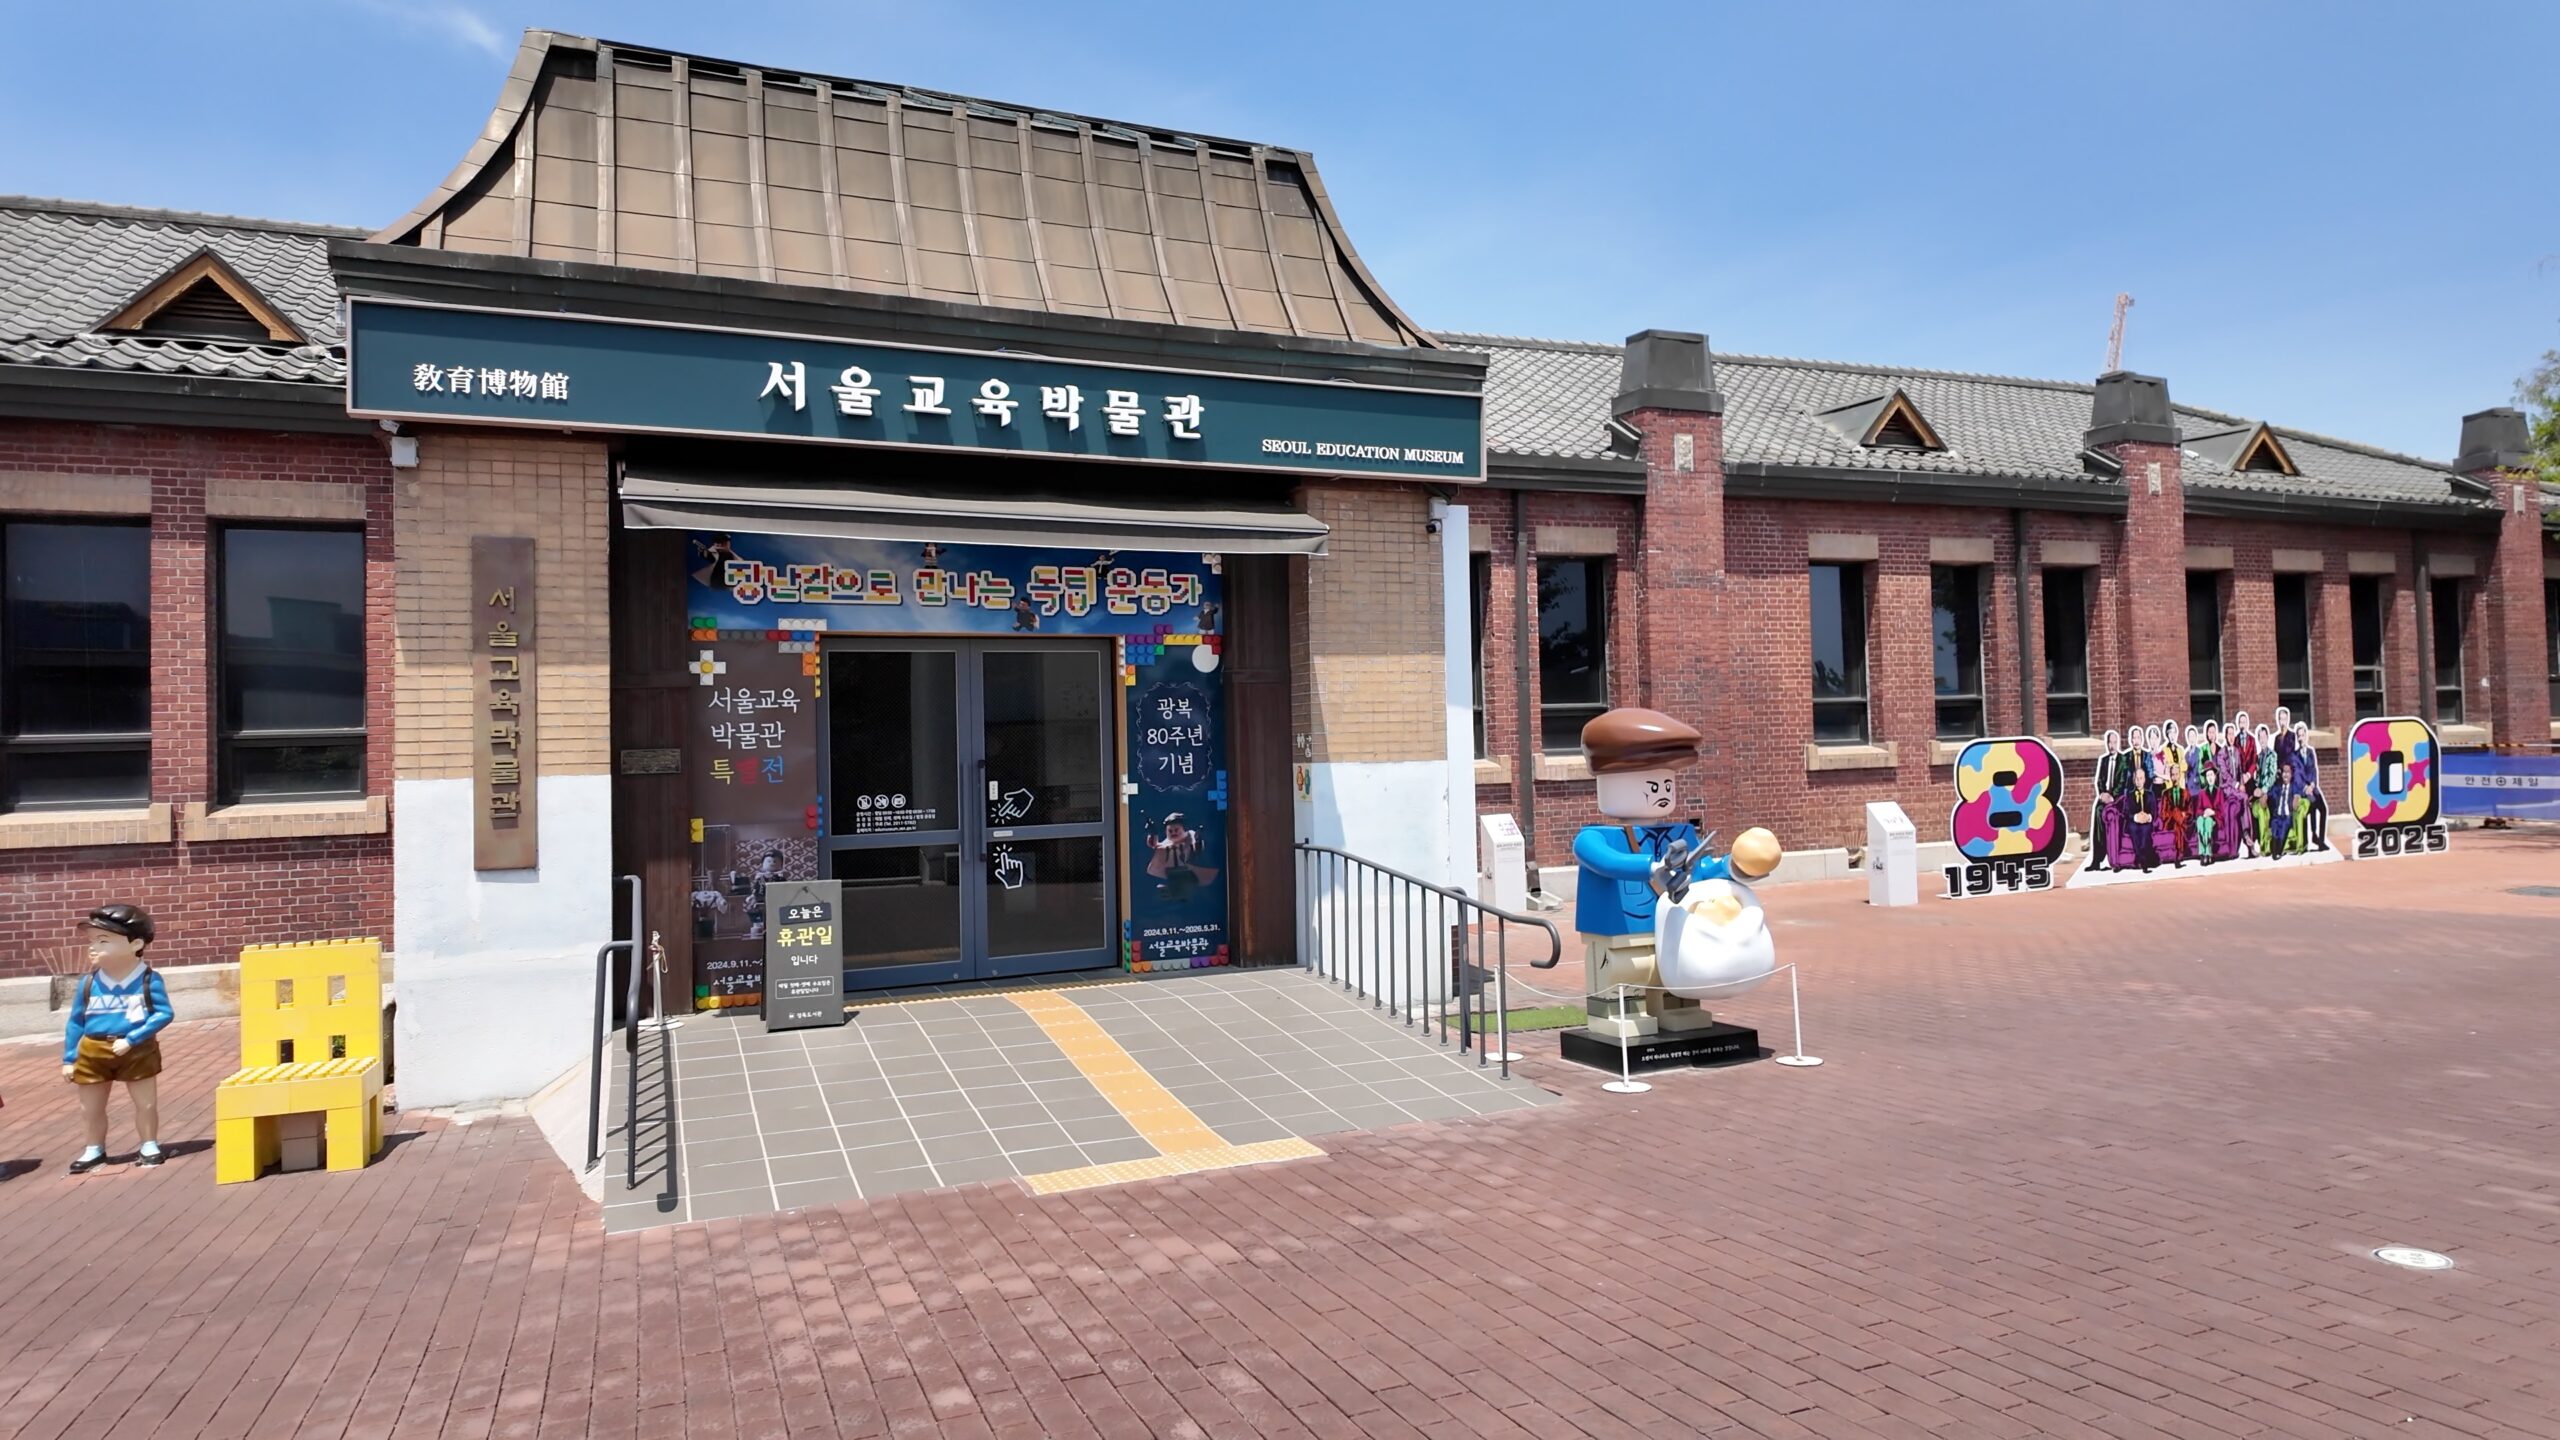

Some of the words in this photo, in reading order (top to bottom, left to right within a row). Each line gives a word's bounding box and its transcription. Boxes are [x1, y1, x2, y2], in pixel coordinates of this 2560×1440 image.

[760, 361, 1205, 440] 서울교육박물관
[1262, 438, 1311, 454] SEOUL
[1316, 443, 1400, 460] EDUCATION
[1404, 449, 1464, 464] MUSEUM
[724, 560, 902, 605] 장난감으로
[913, 569, 1014, 609] 만나는
[1027, 565, 1097, 617] 독립
[1105, 568, 1203, 615] 운동가
[488, 585, 521, 819] 서울교육박물관
[708, 686, 801, 715] 서울교육
[1157, 697, 1193, 720] 광복
[710, 720, 787, 750] 박물관
[1147, 724, 1204, 747] 80주년
[1158, 752, 1194, 775] 기념
[2464, 775, 2492, 787] 안전
[2511, 776, 2540, 787] 제일
[2357, 824, 2447, 859] 2025
[1945, 857, 2052, 897] 1945
[788, 905, 824, 919] 오늘은
[777, 925, 832, 948] 휴관일
[1148, 937, 1209, 958] 서울교육박물관
[790, 953, 819, 966] 입니다
